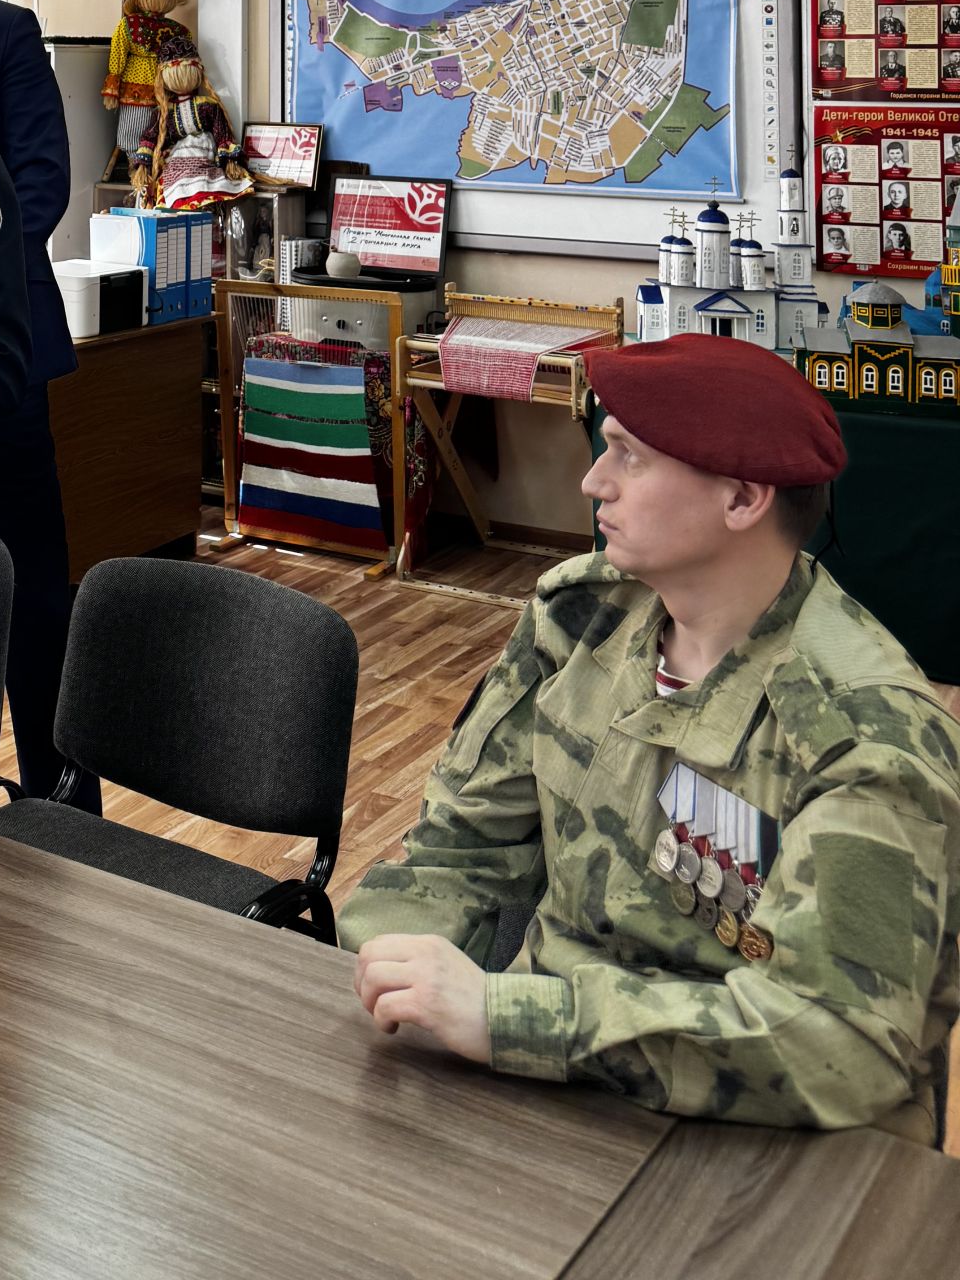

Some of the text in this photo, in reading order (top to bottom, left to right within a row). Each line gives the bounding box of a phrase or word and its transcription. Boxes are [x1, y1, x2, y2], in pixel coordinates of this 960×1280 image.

[822, 109, 884, 123] Дети-герои
[887, 109, 936, 122] Великой
[347, 236, 357, 244] 2
